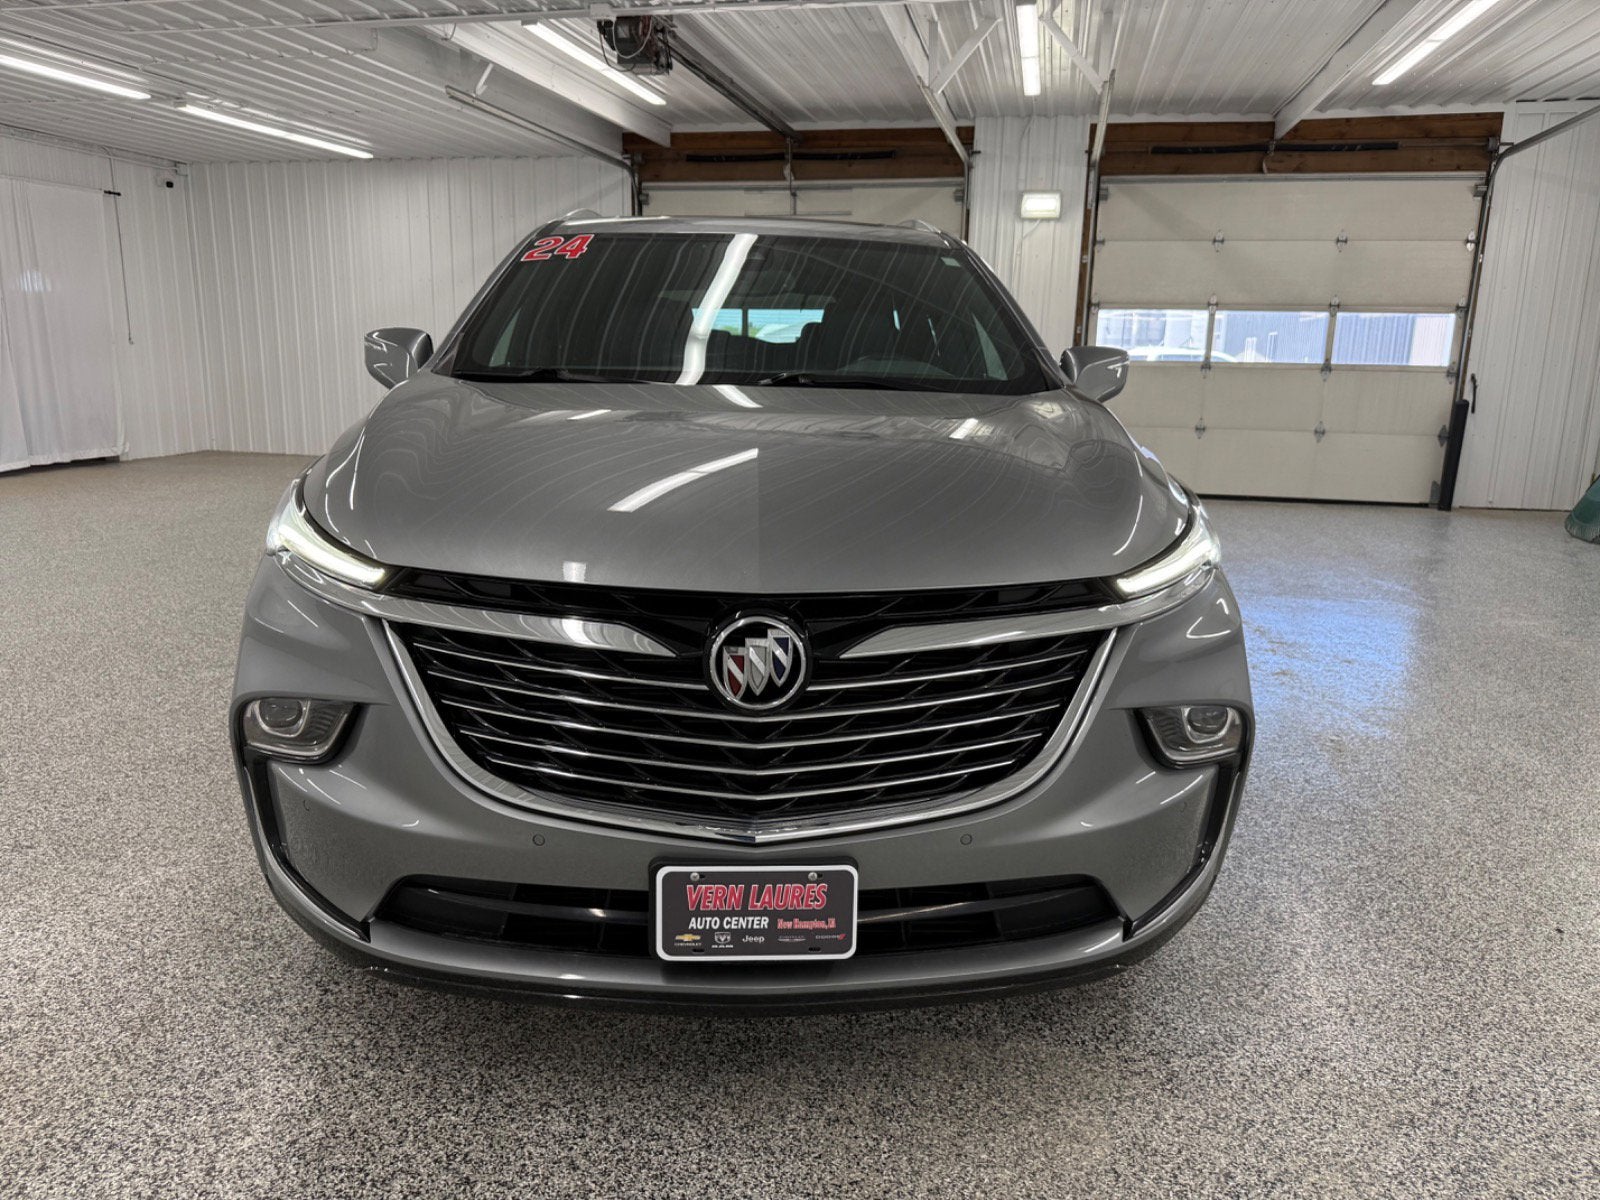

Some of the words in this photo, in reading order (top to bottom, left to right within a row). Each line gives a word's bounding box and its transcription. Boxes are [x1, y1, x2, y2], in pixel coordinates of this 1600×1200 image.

[520, 234, 594, 261] 24
[686, 885, 744, 910] VERN
[748, 884, 828, 910] LAURES
[688, 916, 719, 930] AUTO
[722, 916, 769, 929] CENTER
[777, 918, 792, 929] New
[742, 934, 765, 943] Jeep
